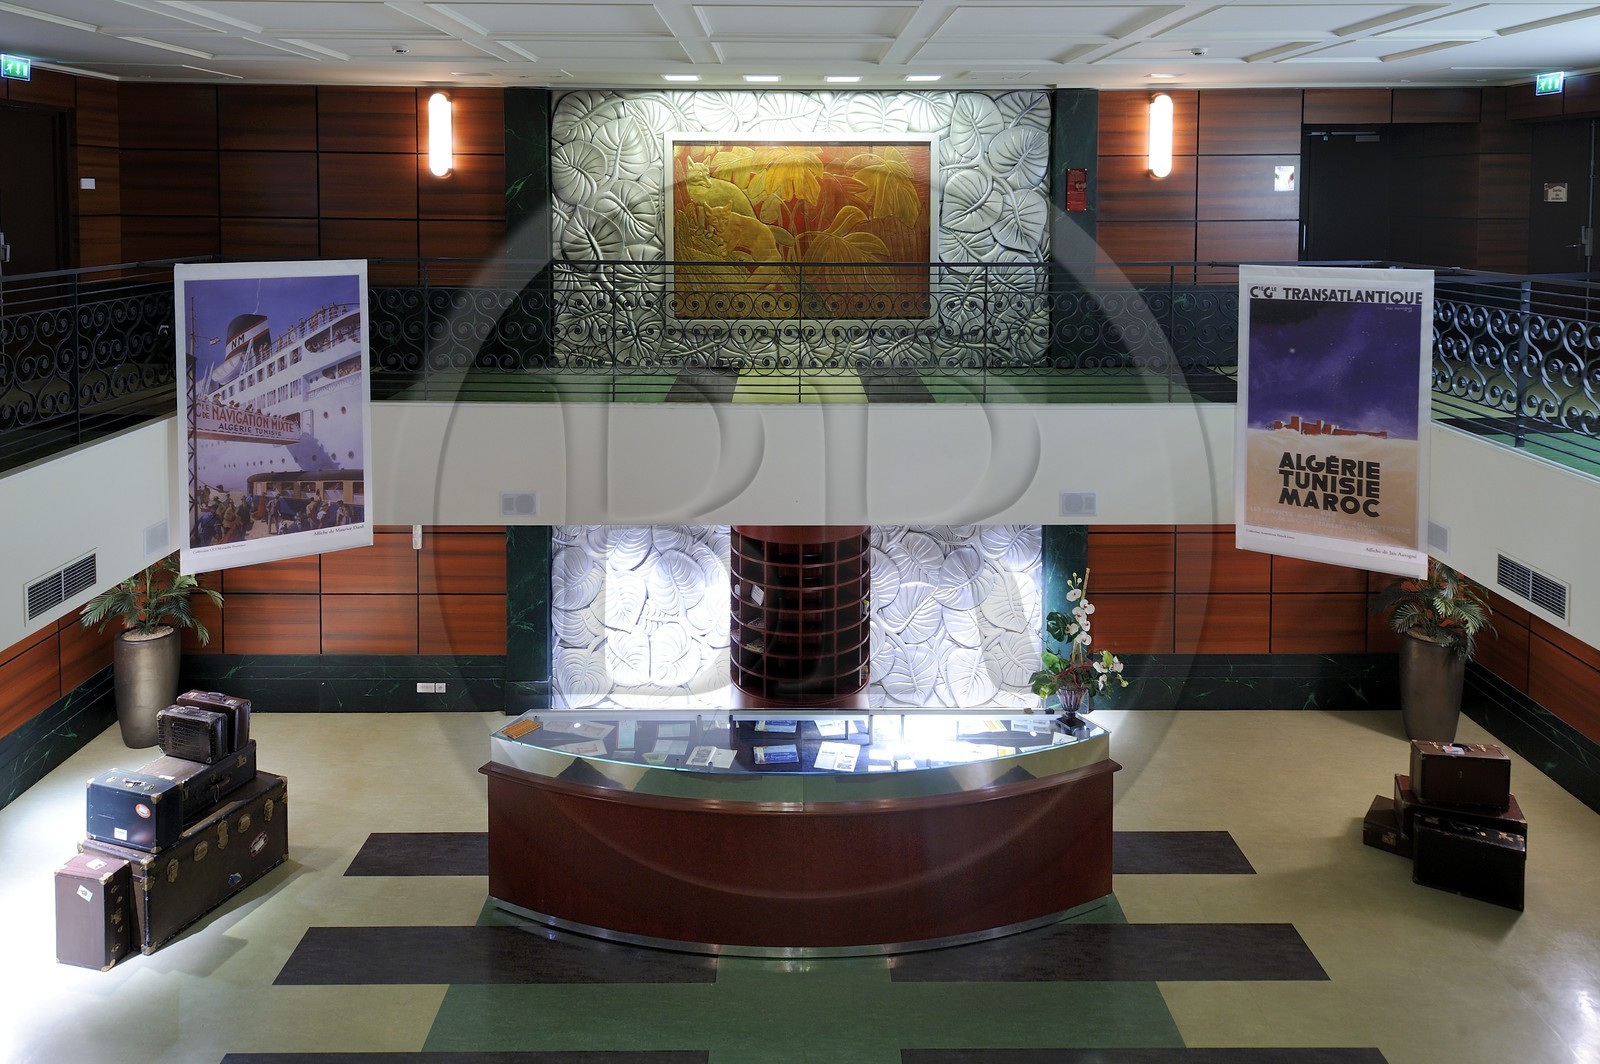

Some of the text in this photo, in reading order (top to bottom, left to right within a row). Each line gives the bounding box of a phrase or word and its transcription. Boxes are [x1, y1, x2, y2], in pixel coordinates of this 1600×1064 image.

[1283, 287, 1422, 304] TRANSATLANTIQUE
[231, 333, 245, 350] NM
[212, 406, 268, 428] NAVIGATION
[271, 419, 293, 433] MIXTE
[255, 427, 282, 437] TUNISIE
[1278, 451, 1380, 480] ALGÉRIE
[1278, 469, 1380, 499] TUNISIE
[1278, 487, 1380, 518] MAROC
